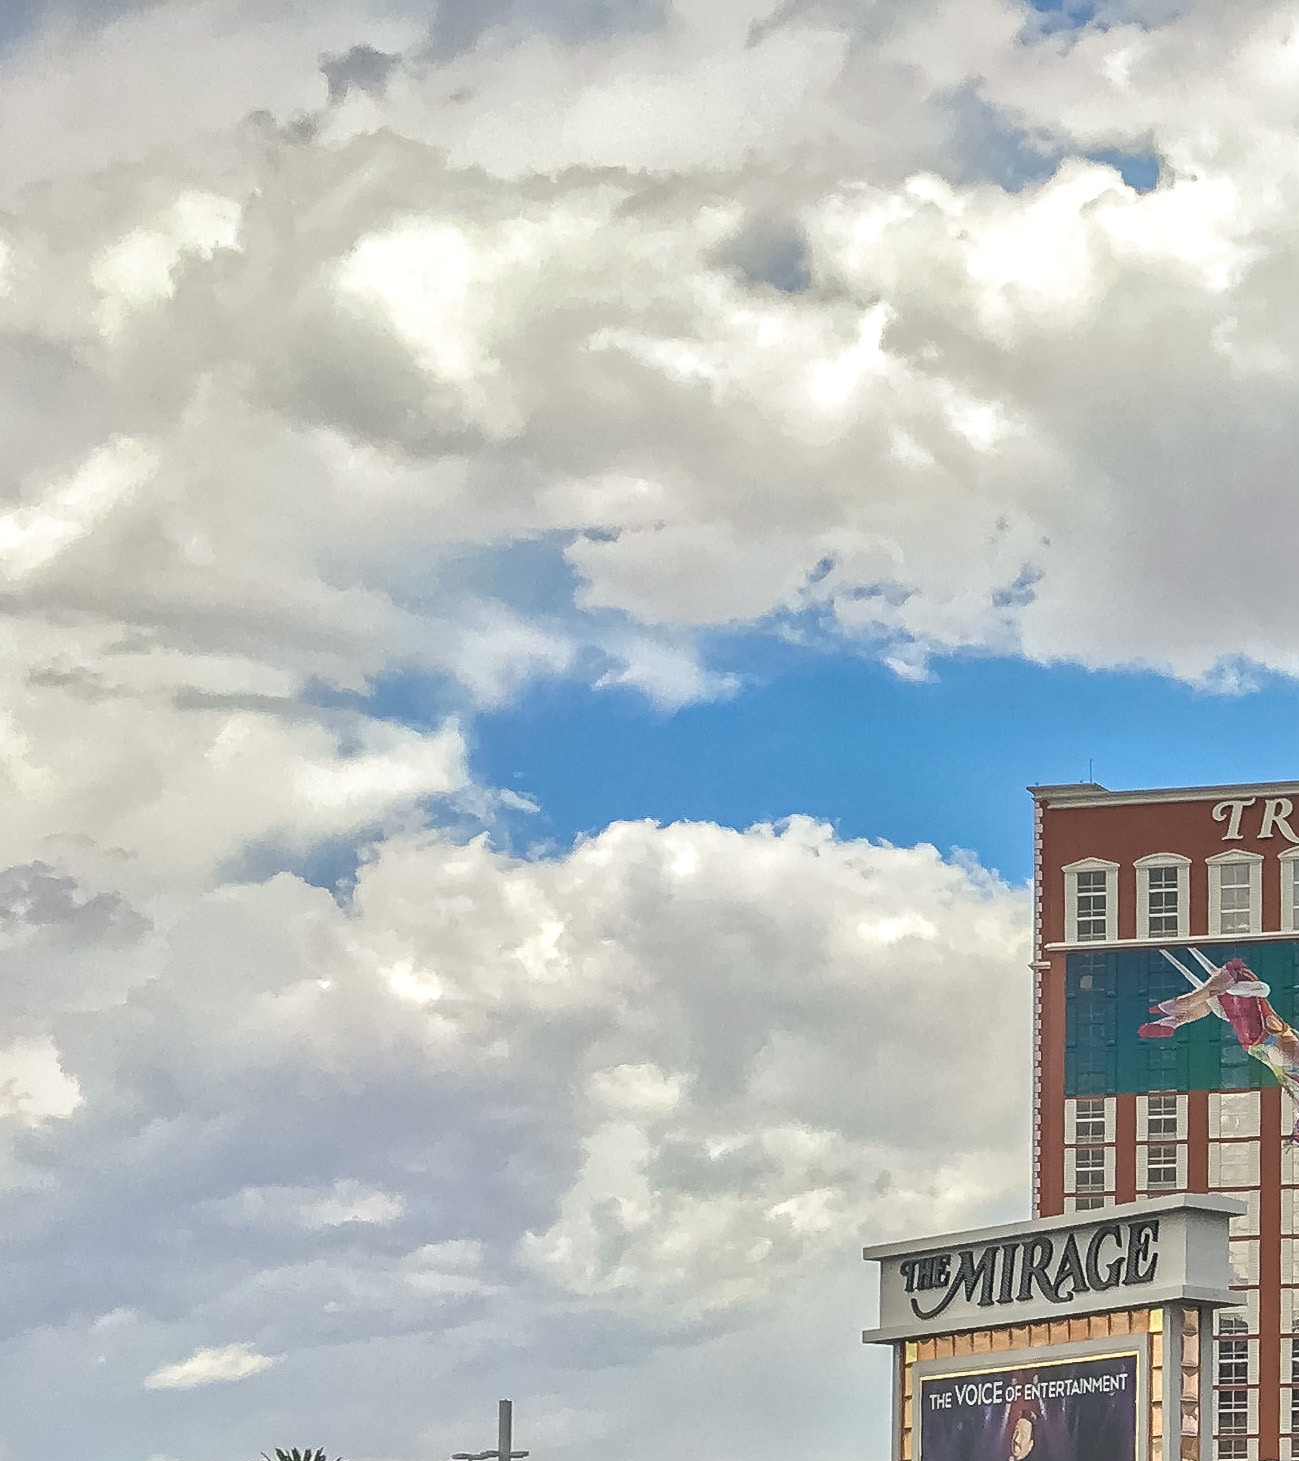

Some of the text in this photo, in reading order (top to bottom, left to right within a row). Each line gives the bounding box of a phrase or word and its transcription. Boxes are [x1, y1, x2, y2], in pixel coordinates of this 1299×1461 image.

[900, 1219, 1159, 1319] THE MIRAGE
[930, 1373, 1128, 1410] THE VOICE OF ENTERTAINMENT
